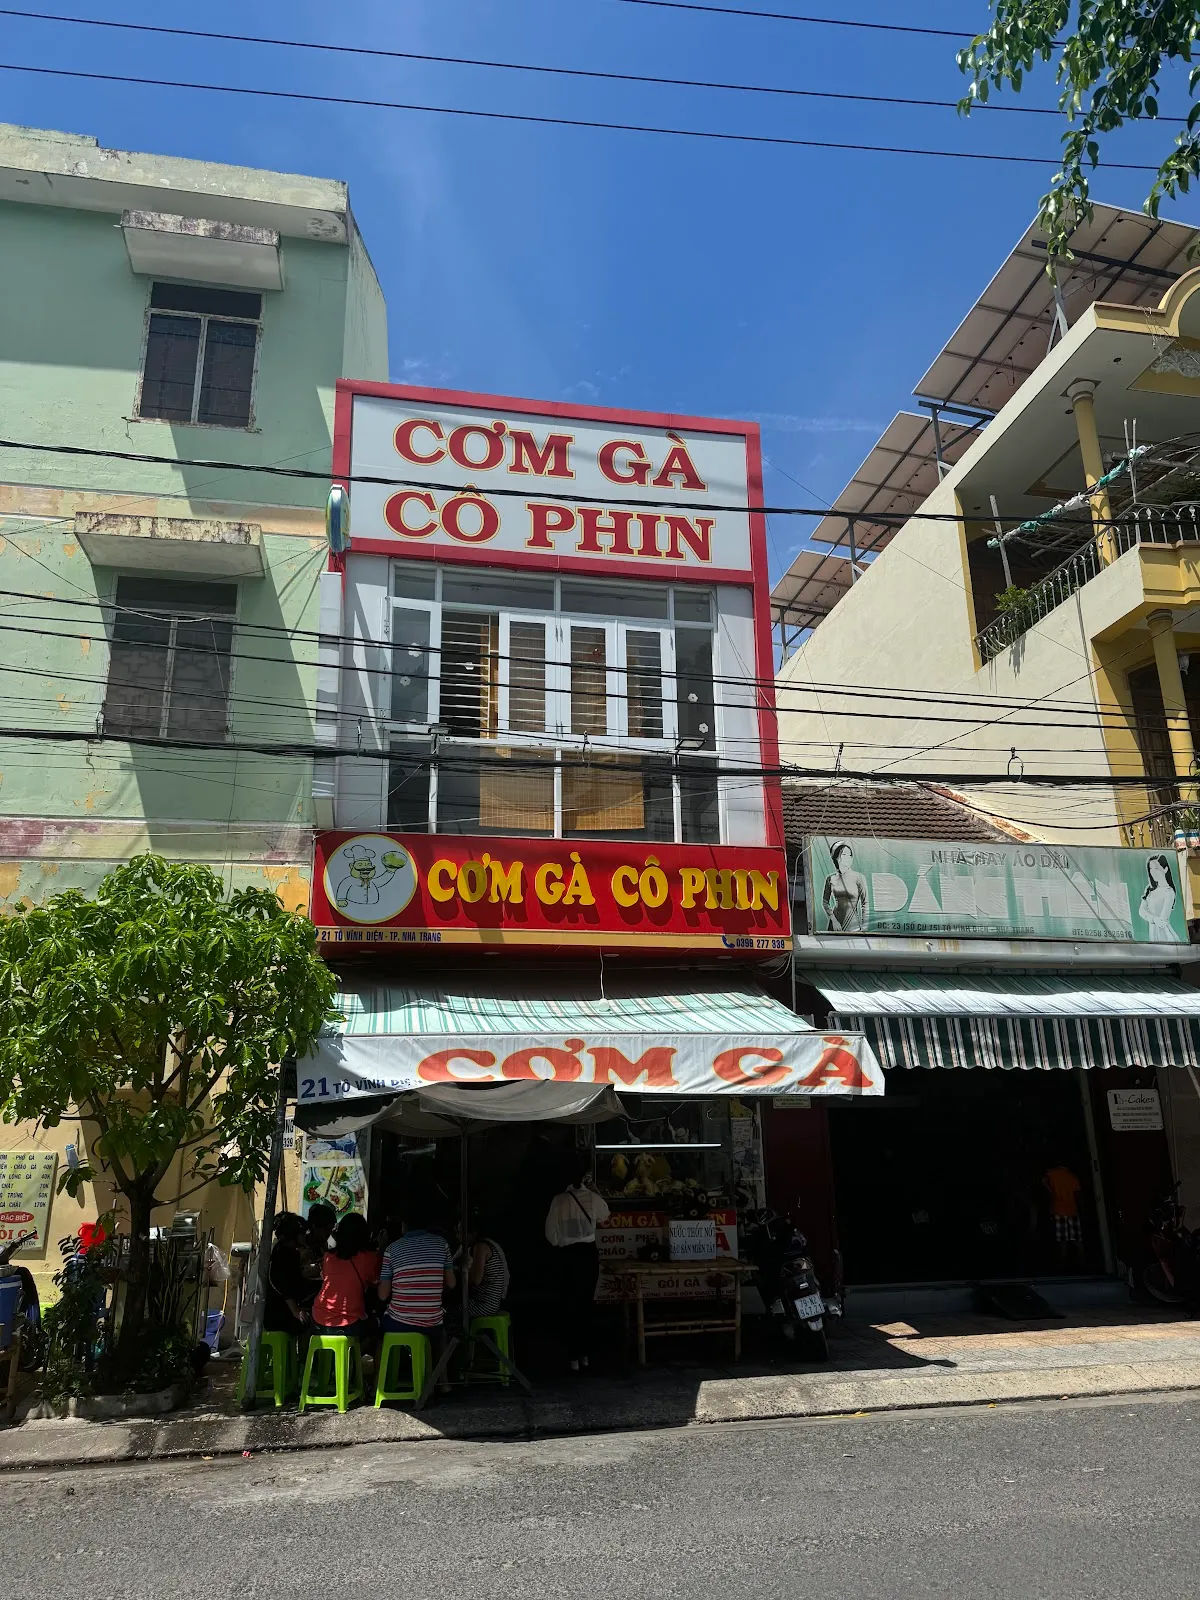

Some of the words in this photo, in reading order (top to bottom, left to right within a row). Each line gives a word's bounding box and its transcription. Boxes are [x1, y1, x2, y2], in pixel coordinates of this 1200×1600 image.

[393, 419, 577, 480] CƠM
[597, 431, 708, 491] GÀ
[384, 484, 502, 544] CÔ
[525, 502, 716, 563] PHIN
[427, 852, 523, 903] CƠM
[535, 852, 596, 906] GÀ
[611, 855, 669, 908] CÔ
[679, 868, 779, 911] PHIN
[321, 930, 331, 941] 21
[402, 932, 416, 942] NHA
[419, 932, 442, 942] TRANG
[756, 938, 770, 949] 277
[416, 1038, 678, 1087] CƠM
[712, 1036, 875, 1087] GÀ
[301, 1077, 330, 1098] 21
[333, 1078, 351, 1094] TÔ
[355, 1076, 386, 1091] VĨNH
[637, 1214, 660, 1227] GÀ
[684, 1276, 700, 1288] GÀ
